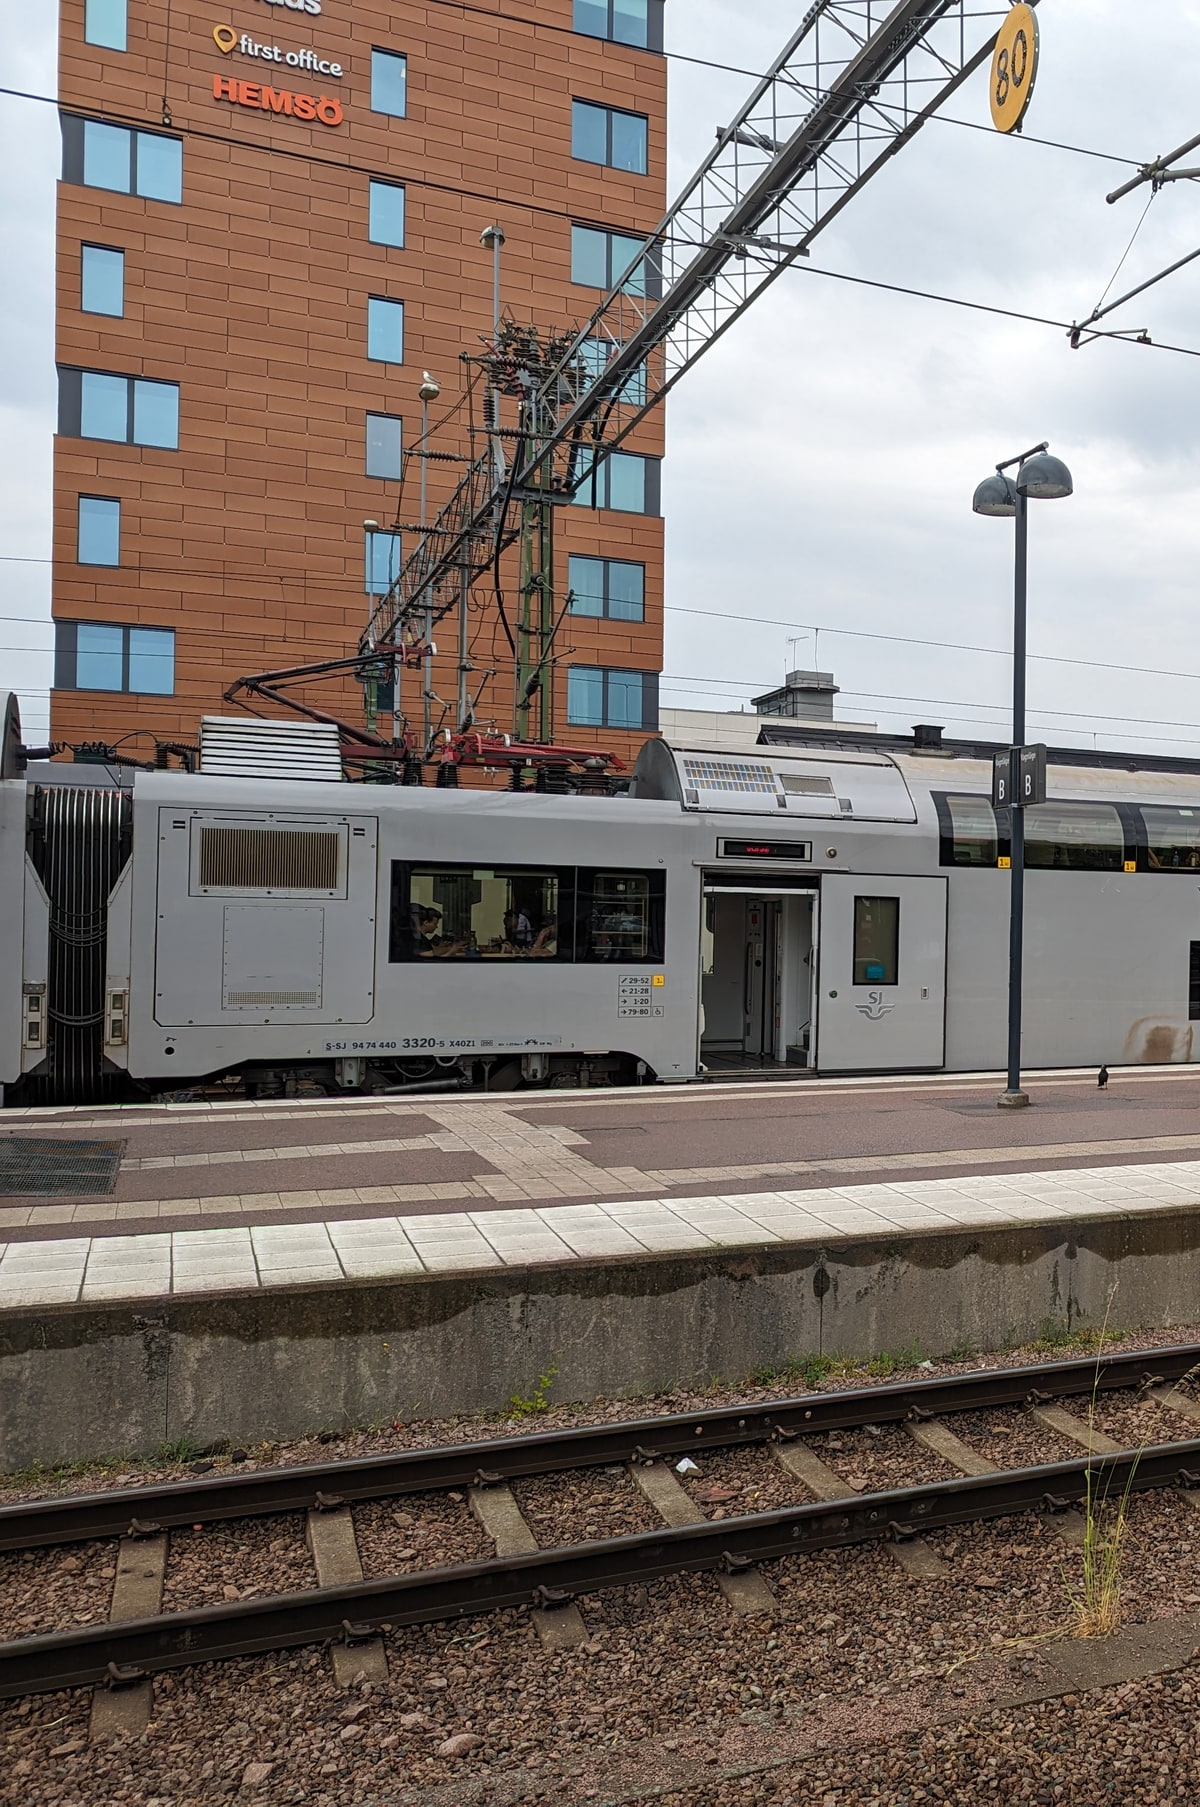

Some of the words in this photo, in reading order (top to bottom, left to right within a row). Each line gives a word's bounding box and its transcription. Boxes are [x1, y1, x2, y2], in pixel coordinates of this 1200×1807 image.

[240, 34, 282, 62] first
[285, 48, 343, 77] office
[996, 29, 1027, 107] 80
[213, 74, 344, 126] HEMSÖ
[999, 779, 1005, 800] B
[1025, 774, 1032, 796] B
[868, 991, 883, 1005] SJ
[352, 1042, 364, 1050] 94
[379, 1041, 397, 1049] 440
[402, 1037, 446, 1049] 3320-5
